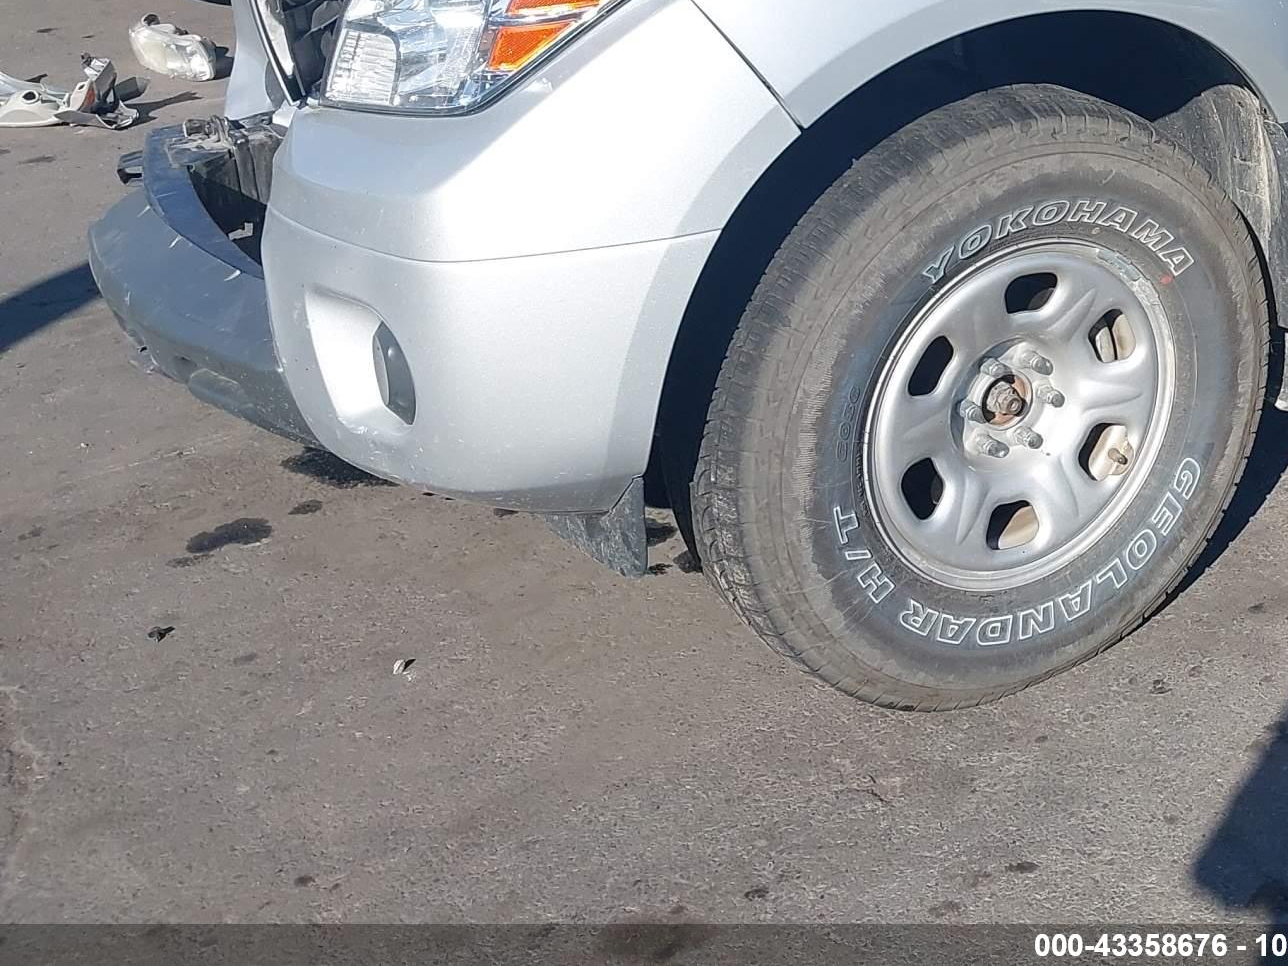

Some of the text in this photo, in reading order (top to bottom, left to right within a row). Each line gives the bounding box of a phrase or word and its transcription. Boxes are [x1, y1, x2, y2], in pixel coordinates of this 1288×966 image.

[922, 200, 1195, 285] YOKOHAMA
[832, 505, 896, 604] H/T
[899, 457, 1202, 646] GEOLANDAR
